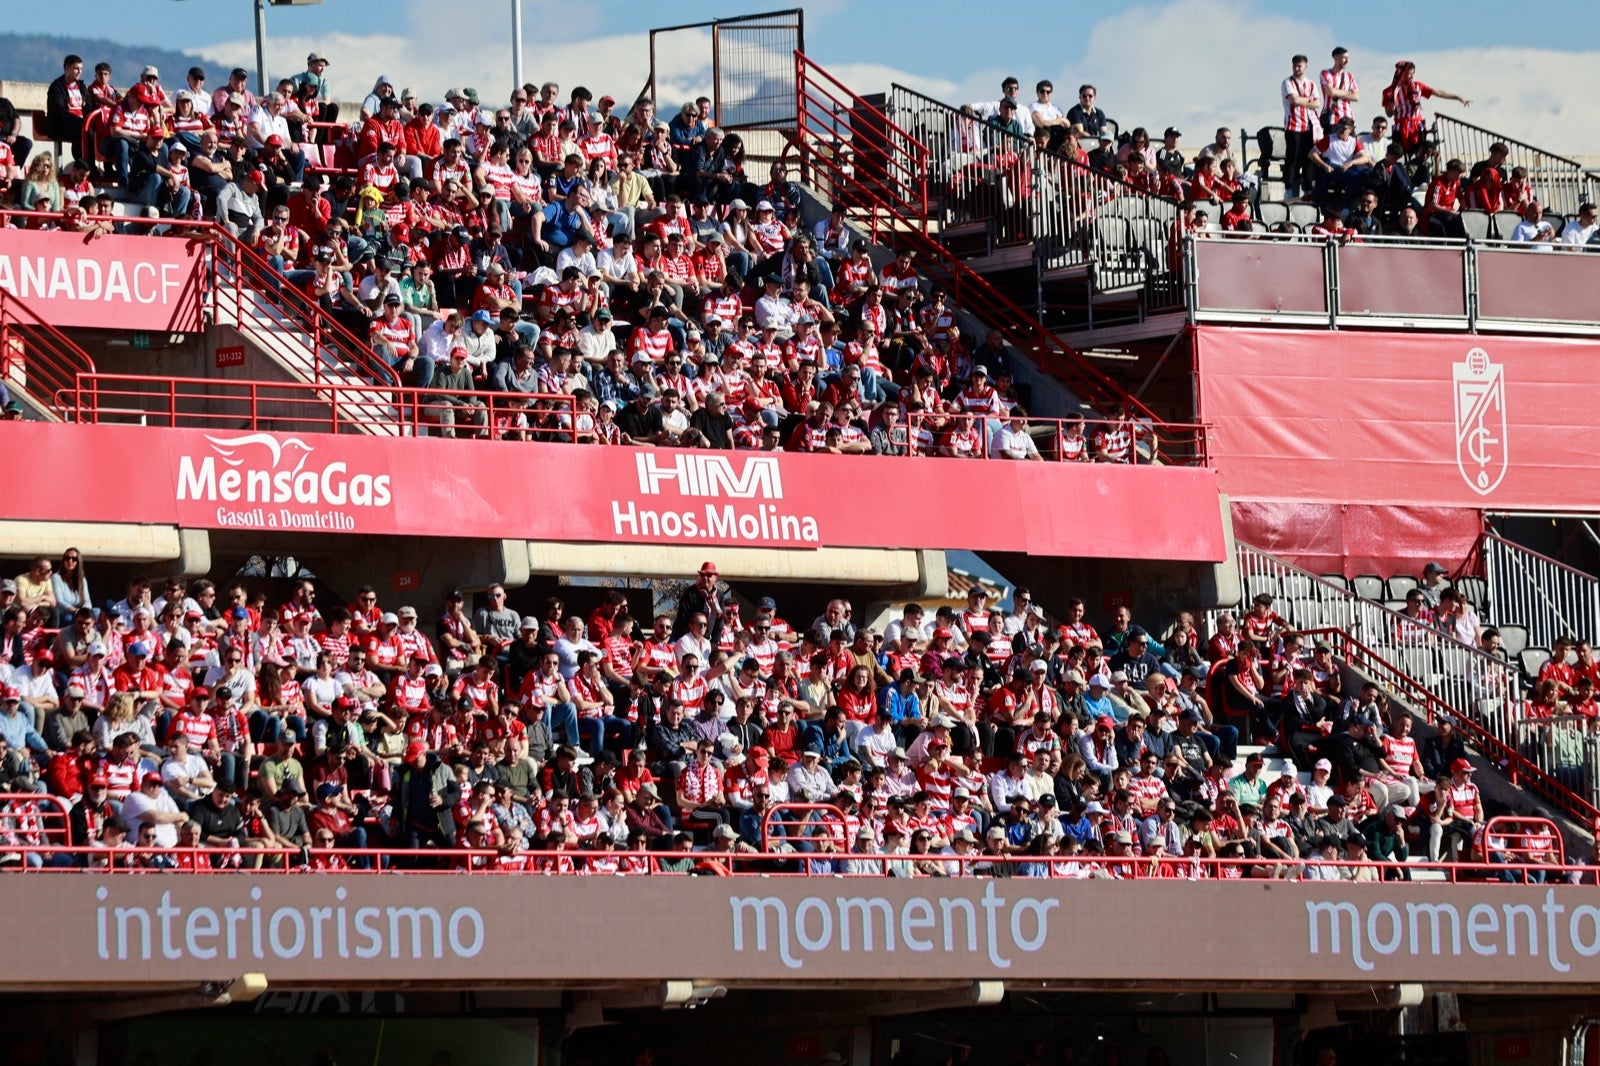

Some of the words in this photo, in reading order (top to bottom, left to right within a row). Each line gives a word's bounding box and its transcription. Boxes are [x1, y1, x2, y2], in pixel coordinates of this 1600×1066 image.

[218, 351, 242, 362] 331-332
[176, 455, 392, 507] MensaGas
[216, 506, 265, 527] Gasoil
[267, 512, 278, 528] a
[280, 509, 355, 530] Domicilio
[1123, 662, 1148, 682] GAP
[96, 886, 485, 961] interiorismo
[729, 881, 1060, 969] momento
